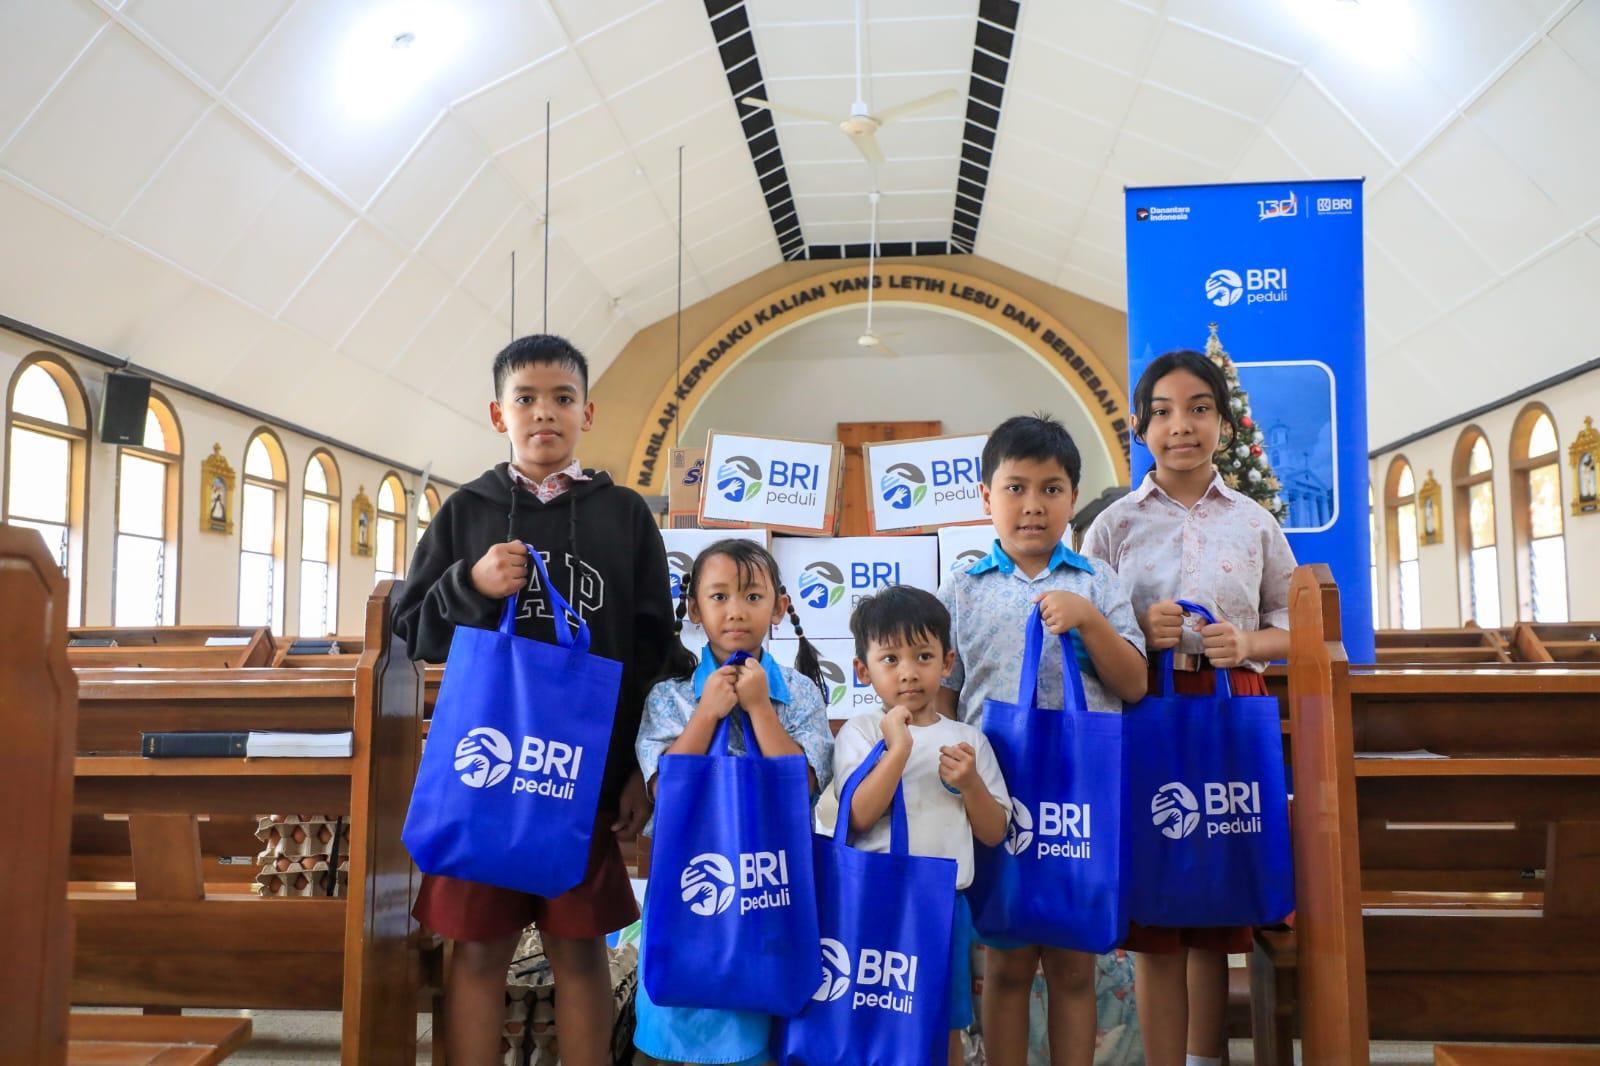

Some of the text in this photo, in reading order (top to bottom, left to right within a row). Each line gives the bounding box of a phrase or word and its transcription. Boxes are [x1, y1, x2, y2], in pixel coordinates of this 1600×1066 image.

[1150, 206, 1190, 214] Danantara
[1332, 198, 1352, 210] BRI
[1150, 213, 1188, 221] Indonesia
[1247, 268, 1287, 290] BRI
[1247, 290, 1288, 305] peduli
[638, 403, 678, 487] MARILAH
[674, 320, 753, 401] KEPADAKU
[754, 285, 826, 326] KALIAN
[829, 275, 882, 294] YANG
[889, 275, 945, 293] LETIH
[950, 283, 999, 310] LESU
[1002, 304, 1041, 333] DAN
[1041, 329, 1119, 416] BERBEBAN
[768, 460, 819, 491] BRI
[931, 456, 981, 487] BRI
[766, 489, 816, 507] peduli
[934, 484, 980, 505] pedul
[851, 562, 900, 588] BRI
[515, 551, 604, 628] AP
[517, 735, 583, 780] BRI
[512, 776, 575, 800] peduli
[1204, 781, 1260, 815] BRI
[1039, 802, 1091, 838] BRI
[1206, 816, 1262, 838] peduli
[1037, 840, 1091, 860] peduli
[739, 850, 789, 890] BRI
[740, 888, 791, 916] peduli
[856, 948, 918, 993] BRI
[852, 991, 913, 1014] peduli
